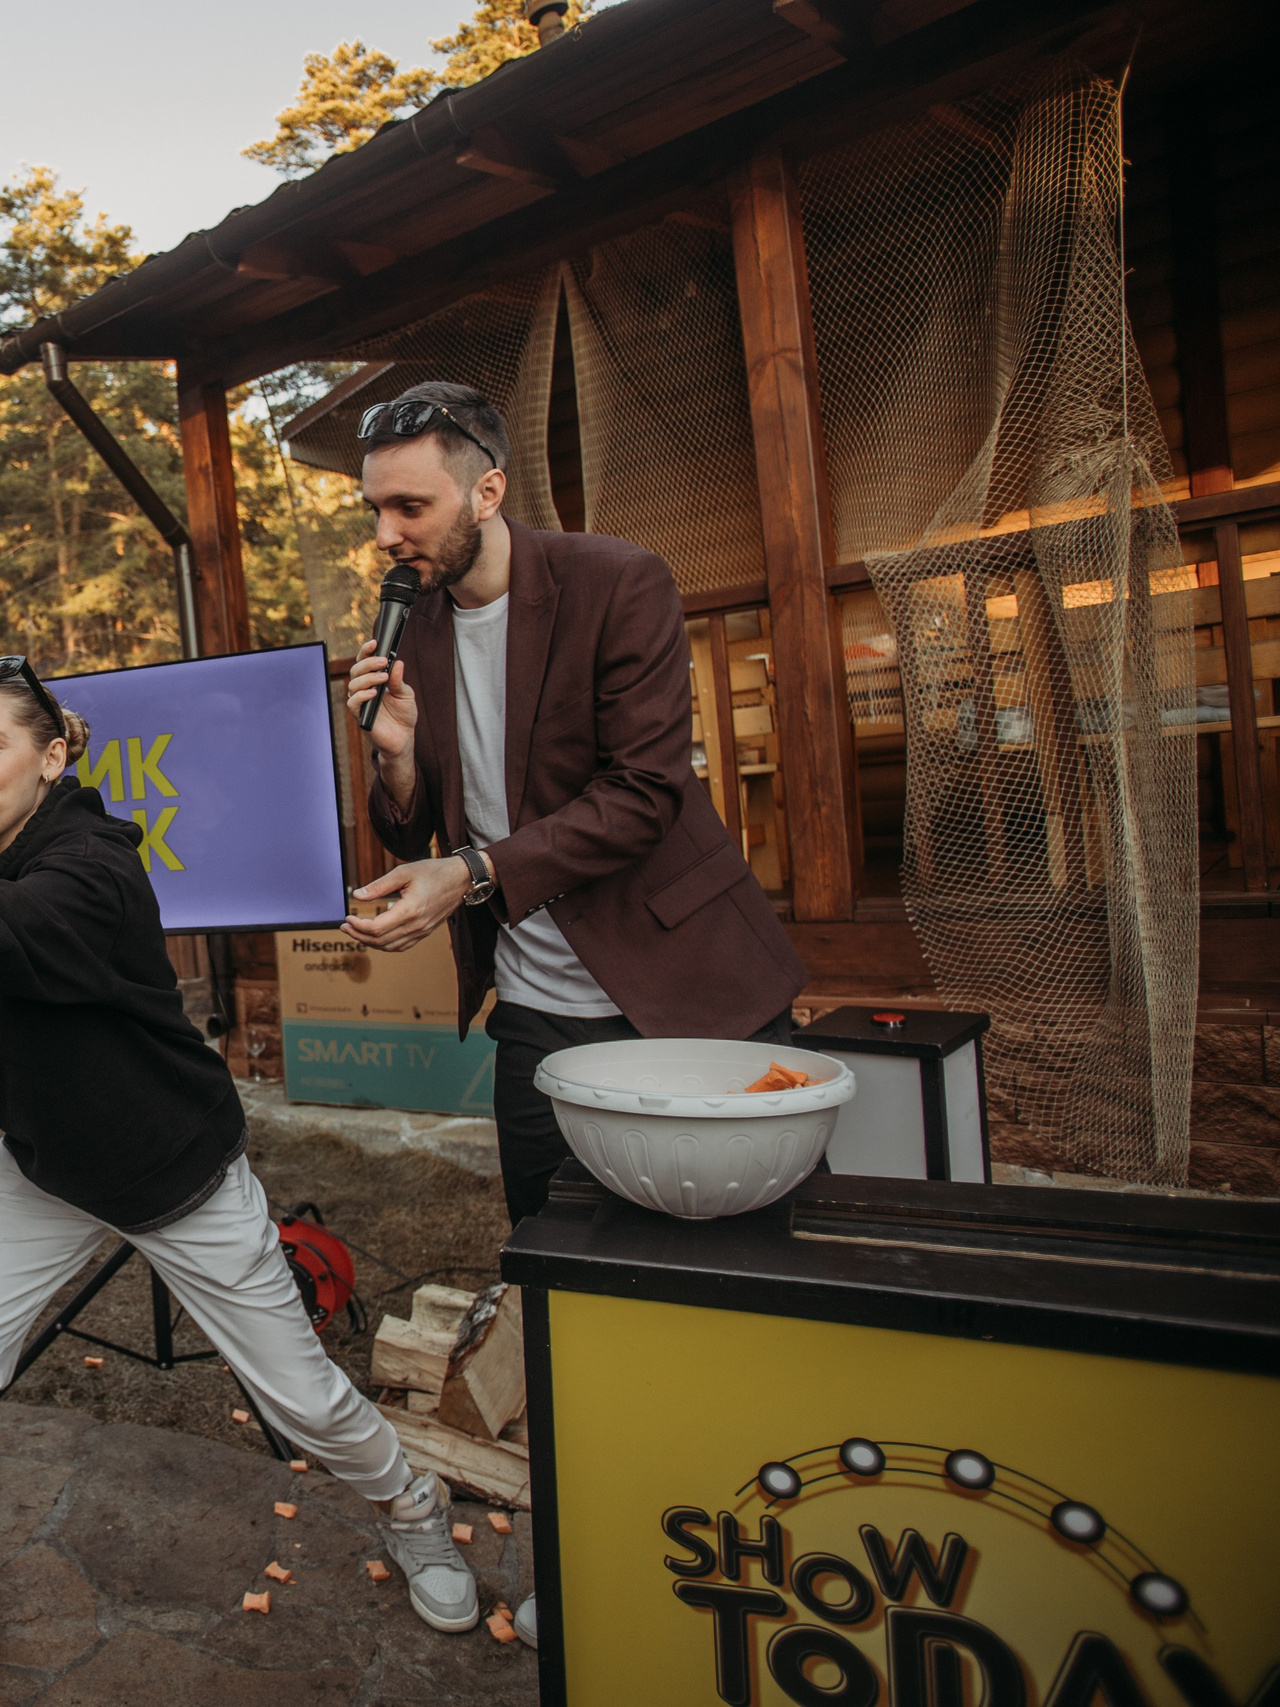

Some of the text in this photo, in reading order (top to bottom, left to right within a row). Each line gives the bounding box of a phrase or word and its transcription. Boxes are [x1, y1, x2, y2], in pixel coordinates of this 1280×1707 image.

[54, 732, 181, 803] ИК
[292, 938, 367, 952] Hisense
[297, 1037, 437, 1069] SMART TV
[661, 1505, 971, 1626] SHOW
